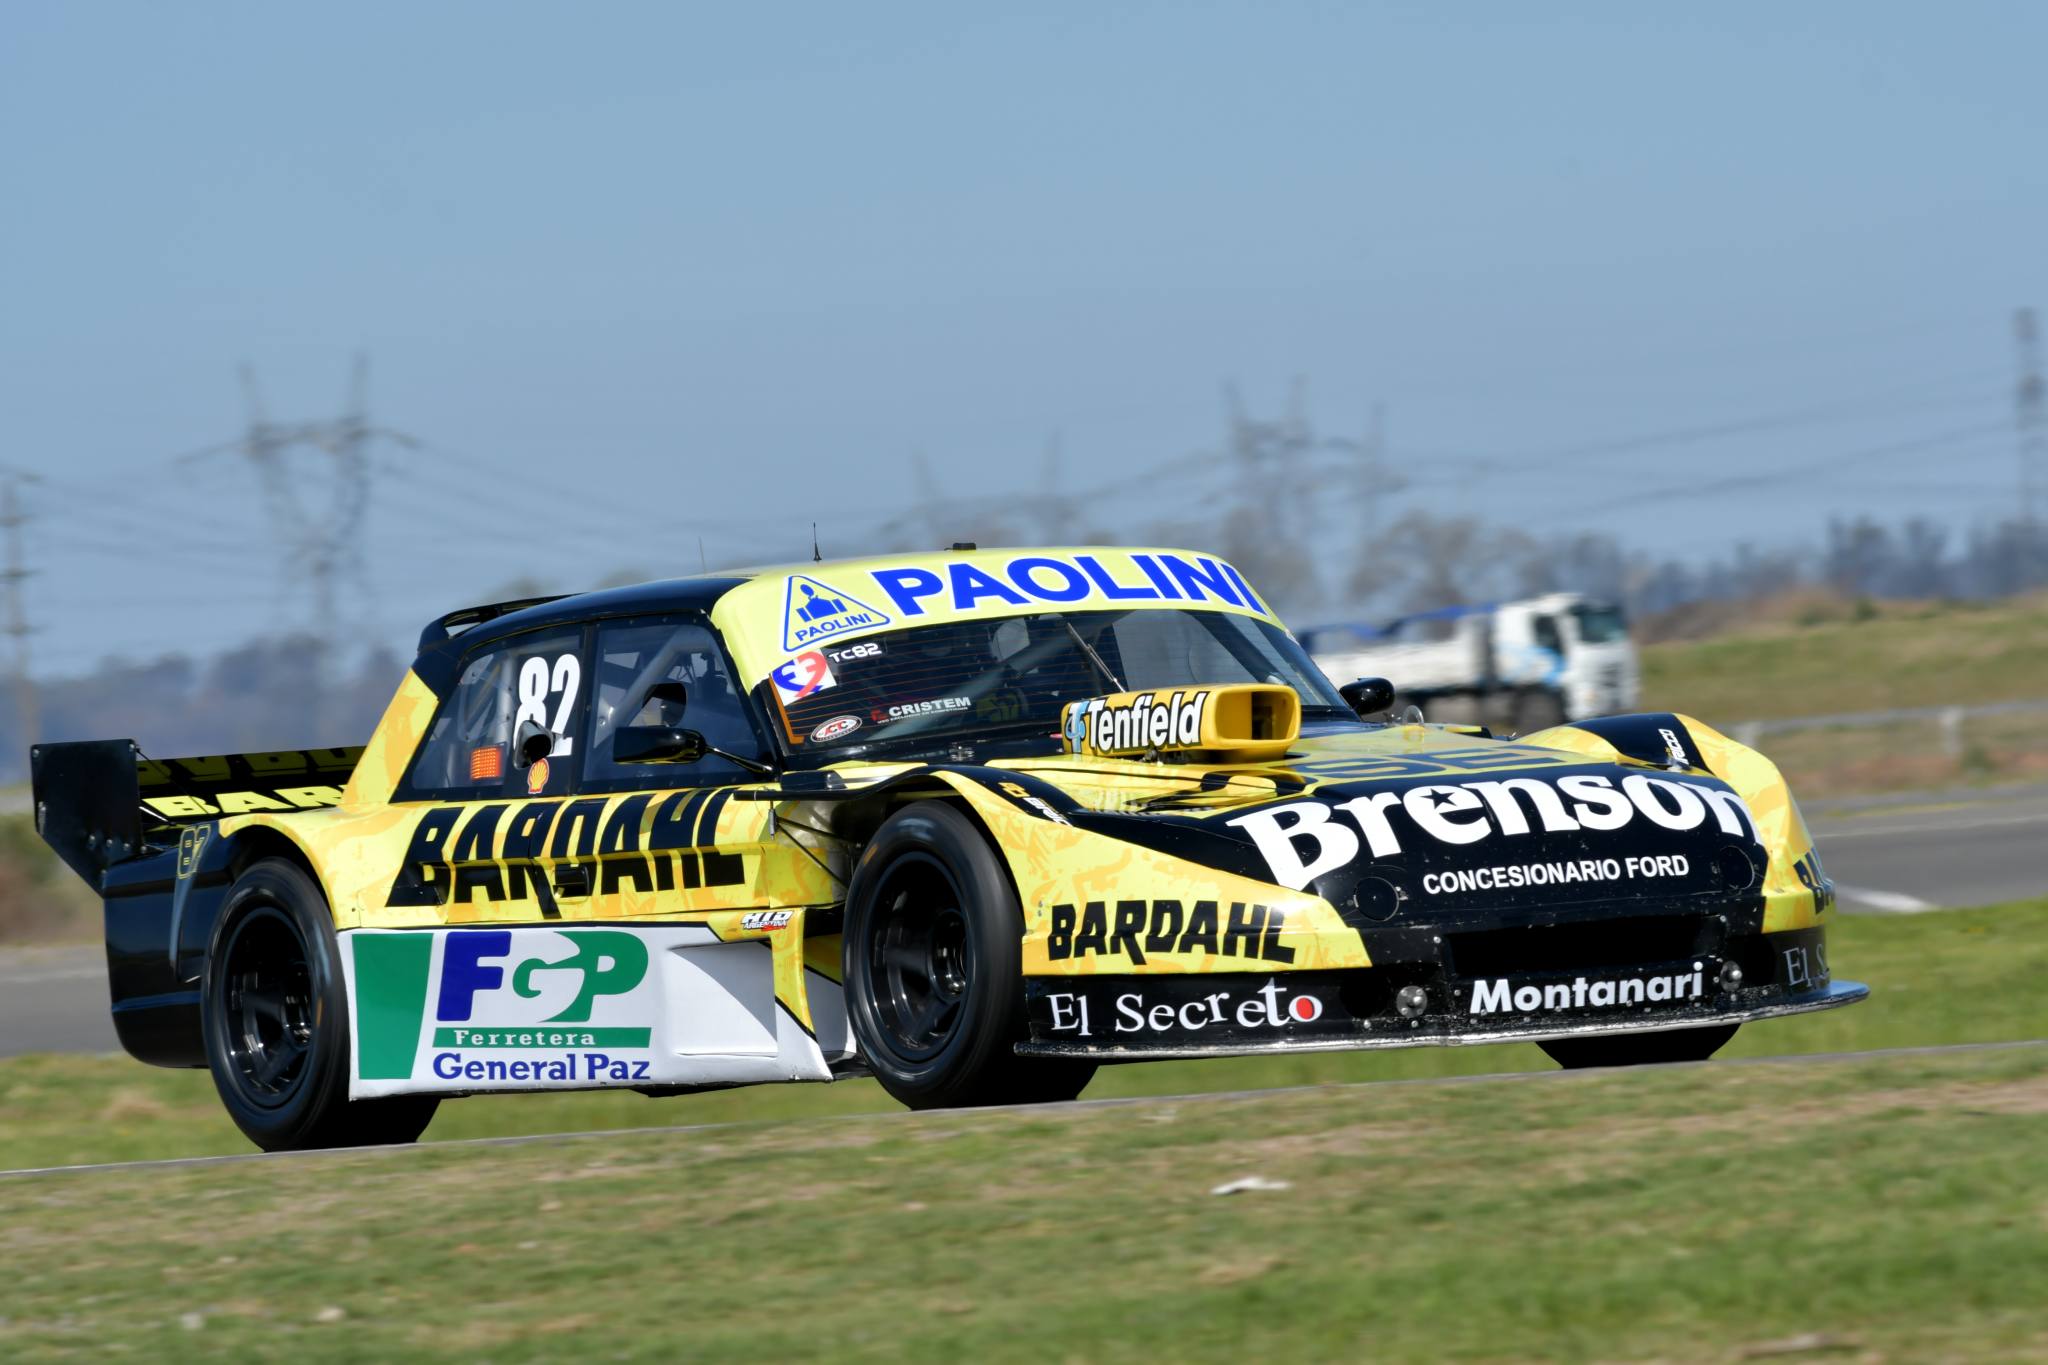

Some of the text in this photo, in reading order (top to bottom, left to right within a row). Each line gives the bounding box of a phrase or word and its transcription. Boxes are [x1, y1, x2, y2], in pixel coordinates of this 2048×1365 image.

[869, 555, 1268, 617] PAOLINI
[795, 613, 872, 641] PAOLINI
[514, 653, 581, 756] 82
[888, 696, 972, 718] CRISTEM
[1087, 691, 1208, 752] Tenfield
[142, 784, 348, 817] BAR
[384, 786, 745, 920] BARDAHL
[1227, 773, 1764, 893] Brenson
[1422, 855, 1690, 896] CONCESIONARIO FORD
[1048, 900, 1296, 965] BARDAHL
[1470, 962, 1703, 1014] Montanari
[1783, 947, 1812, 987] El
[1045, 977, 1322, 1036] El Secreto
[455, 1029, 596, 1046] Ferretera
[433, 1051, 650, 1081] General Paz
